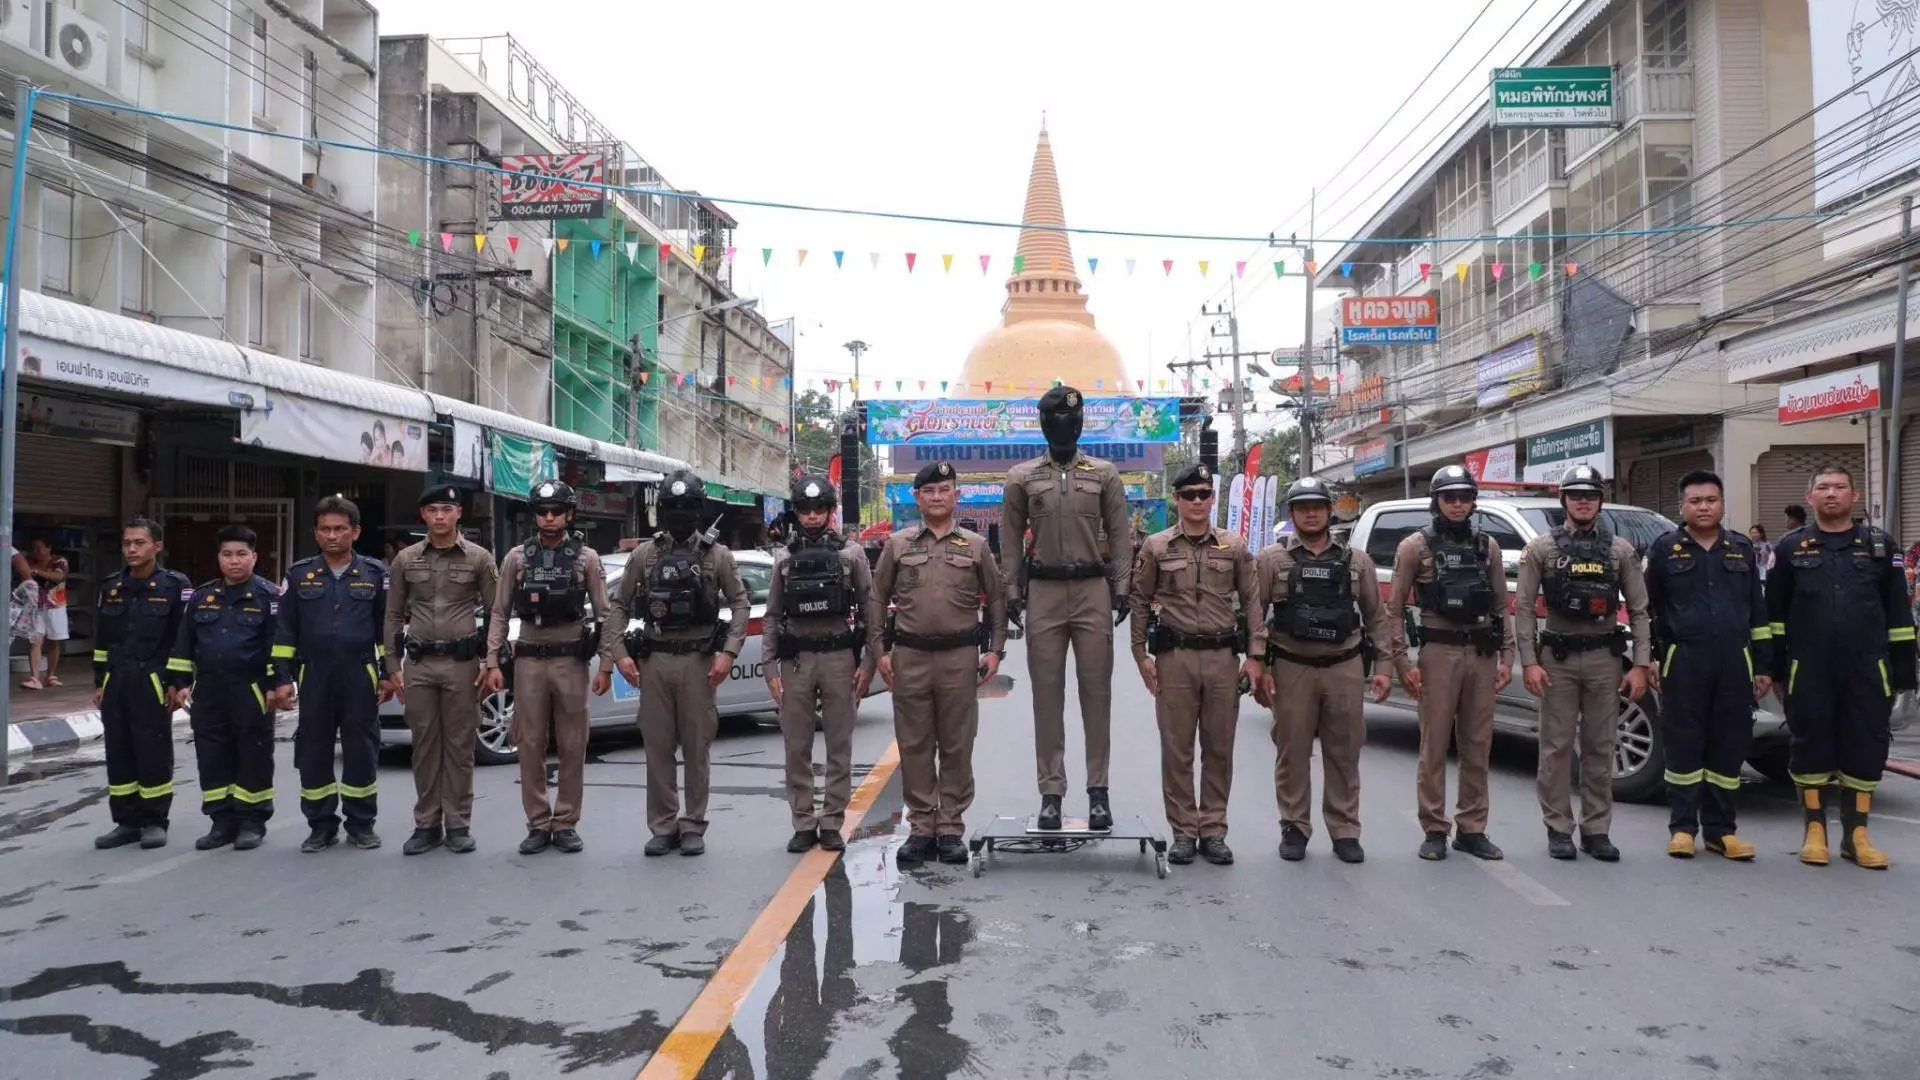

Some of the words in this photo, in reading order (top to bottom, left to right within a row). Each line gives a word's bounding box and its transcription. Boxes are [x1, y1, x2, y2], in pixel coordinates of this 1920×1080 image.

[1498, 83, 1608, 104] หมอพิทักษ์พงศ์
[1349, 301, 1362, 325] หู
[1363, 300, 1390, 320] คอ
[1391, 299, 1431, 325] จมูก
[1387, 327, 1433, 341] โรคทั่วไป
[1303, 567, 1330, 578] POLICE
[1571, 563, 1604, 574] POLICE
[799, 600, 829, 613] POLICE
[730, 662, 764, 680] OLIC
